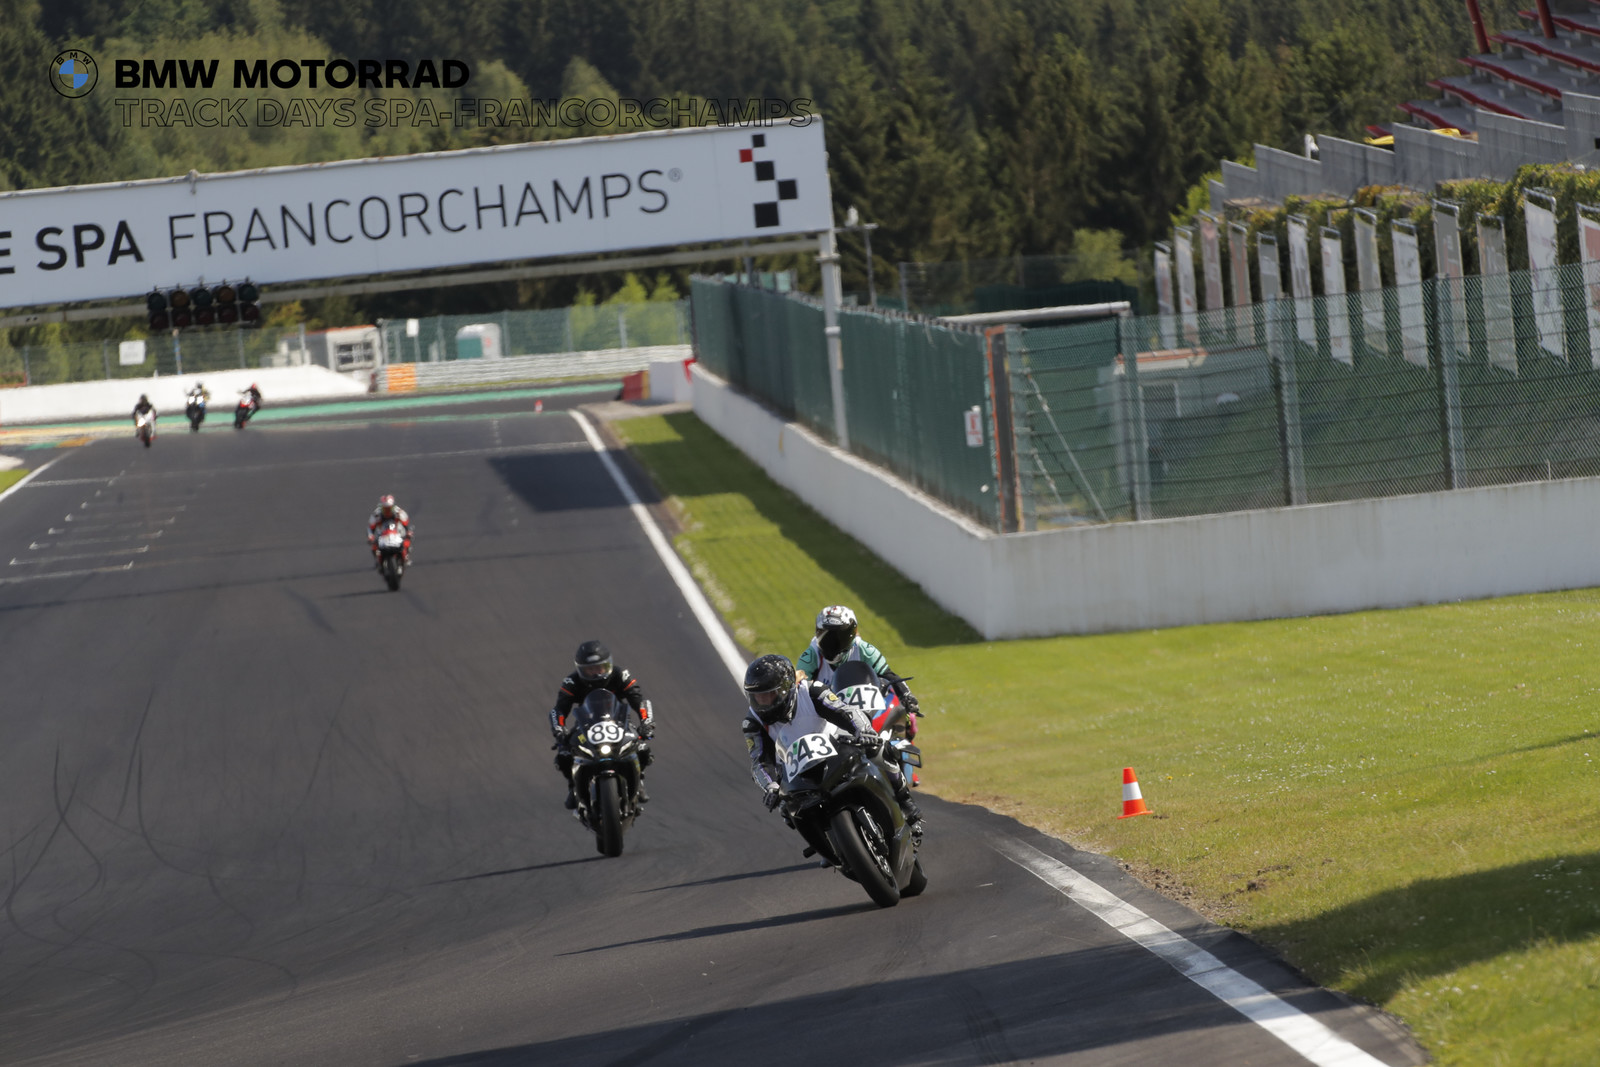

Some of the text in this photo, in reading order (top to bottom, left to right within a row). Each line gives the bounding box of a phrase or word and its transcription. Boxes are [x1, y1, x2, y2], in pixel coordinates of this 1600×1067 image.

[35, 220, 144, 271] SPA
[591, 724, 620, 742] 89
[785, 735, 833, 777] 343
